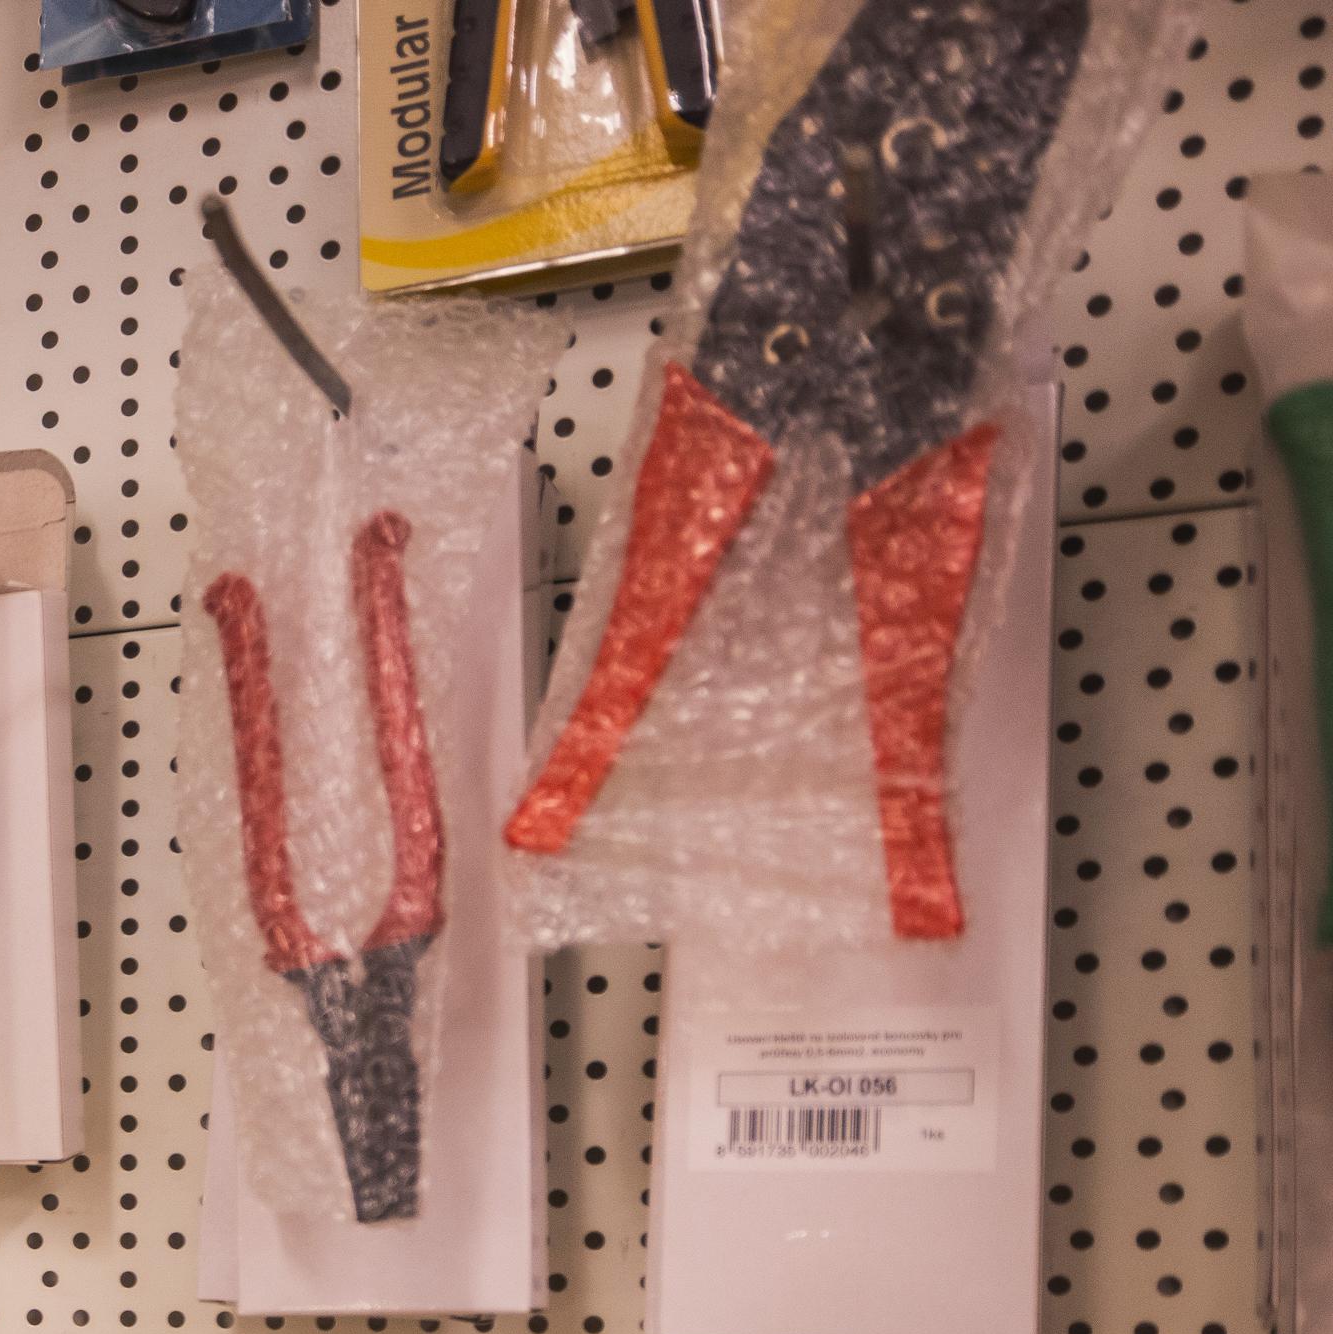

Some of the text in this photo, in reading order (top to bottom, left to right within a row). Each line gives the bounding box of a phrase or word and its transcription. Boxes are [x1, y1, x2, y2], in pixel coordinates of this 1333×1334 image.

[392, 15, 431, 200] Modular
[789, 1076, 898, 1098] LK-OI 056
